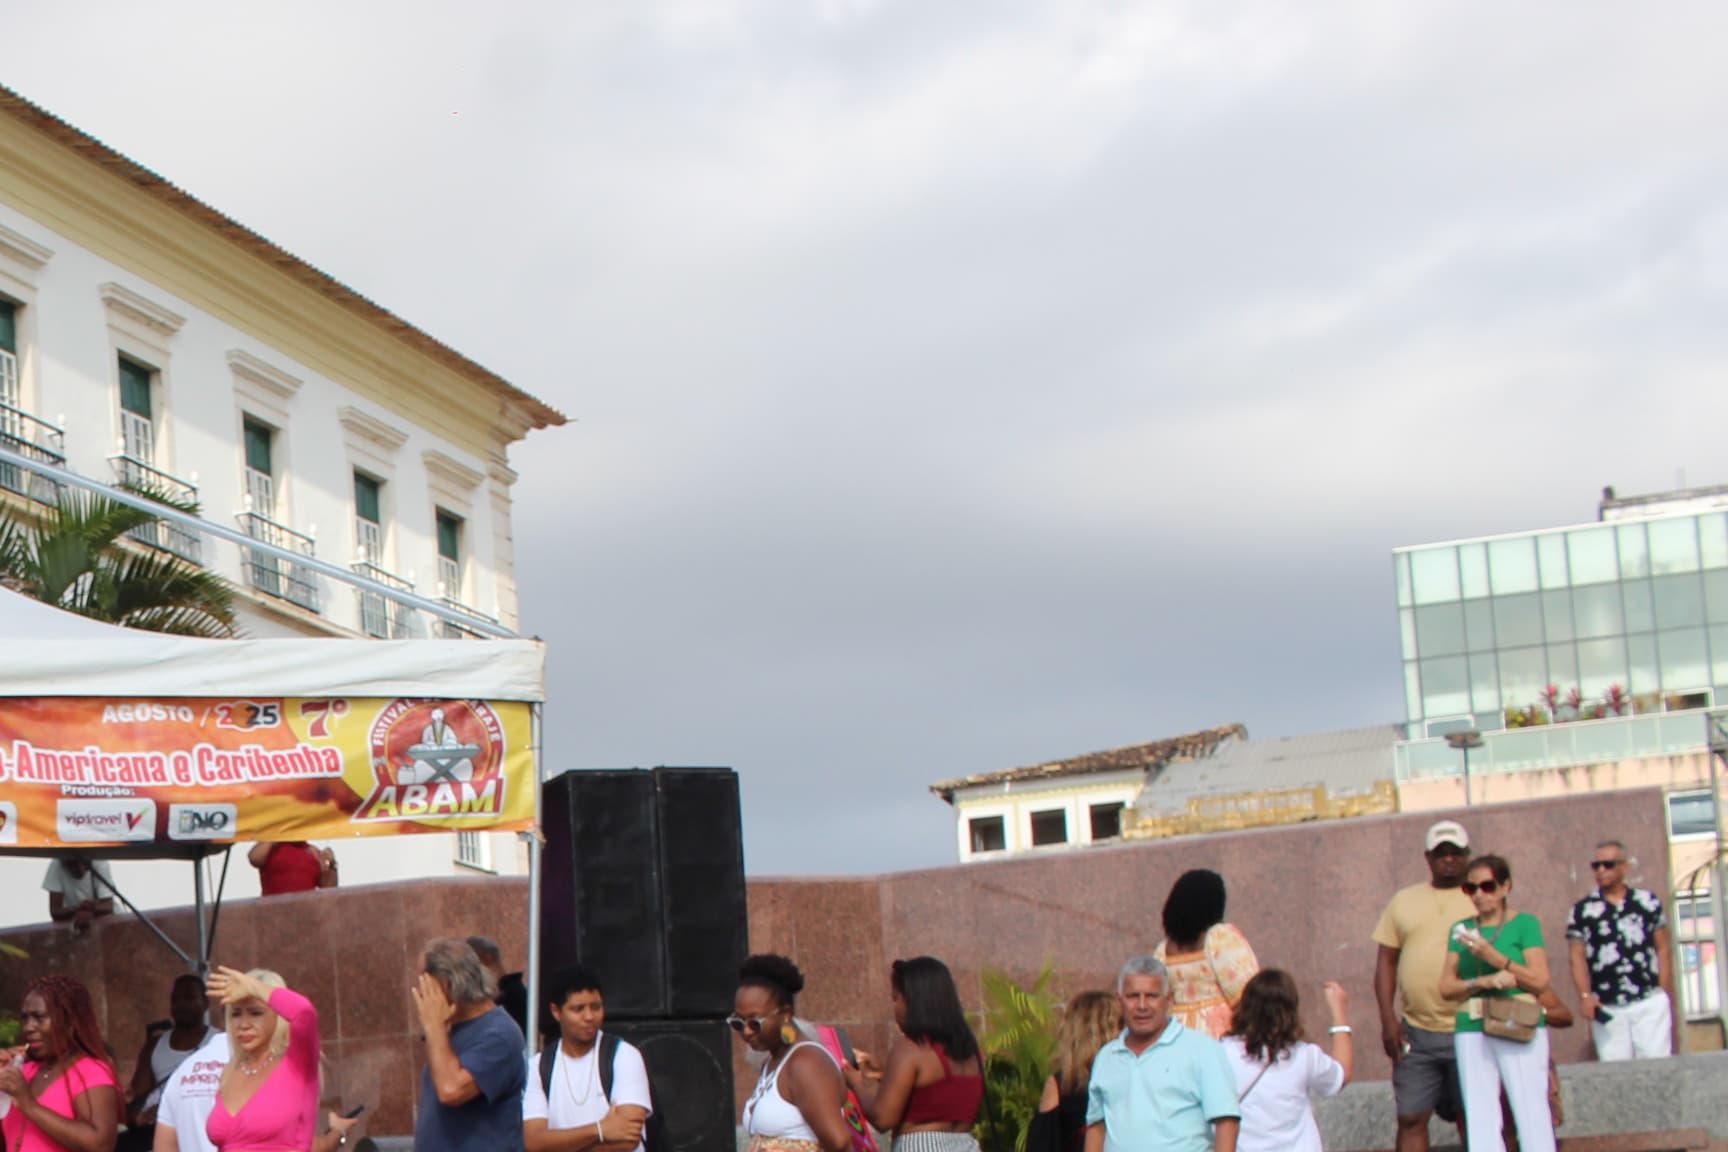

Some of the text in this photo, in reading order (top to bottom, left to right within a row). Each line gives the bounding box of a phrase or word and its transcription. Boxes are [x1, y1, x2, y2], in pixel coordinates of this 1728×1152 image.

[101, 703, 195, 724] AGOSTO
[173, 753, 192, 784] e
[196, 745, 342, 784] Caribenha
[61, 785, 136, 798] Produção:
[366, 779, 498, 820] ABAM
